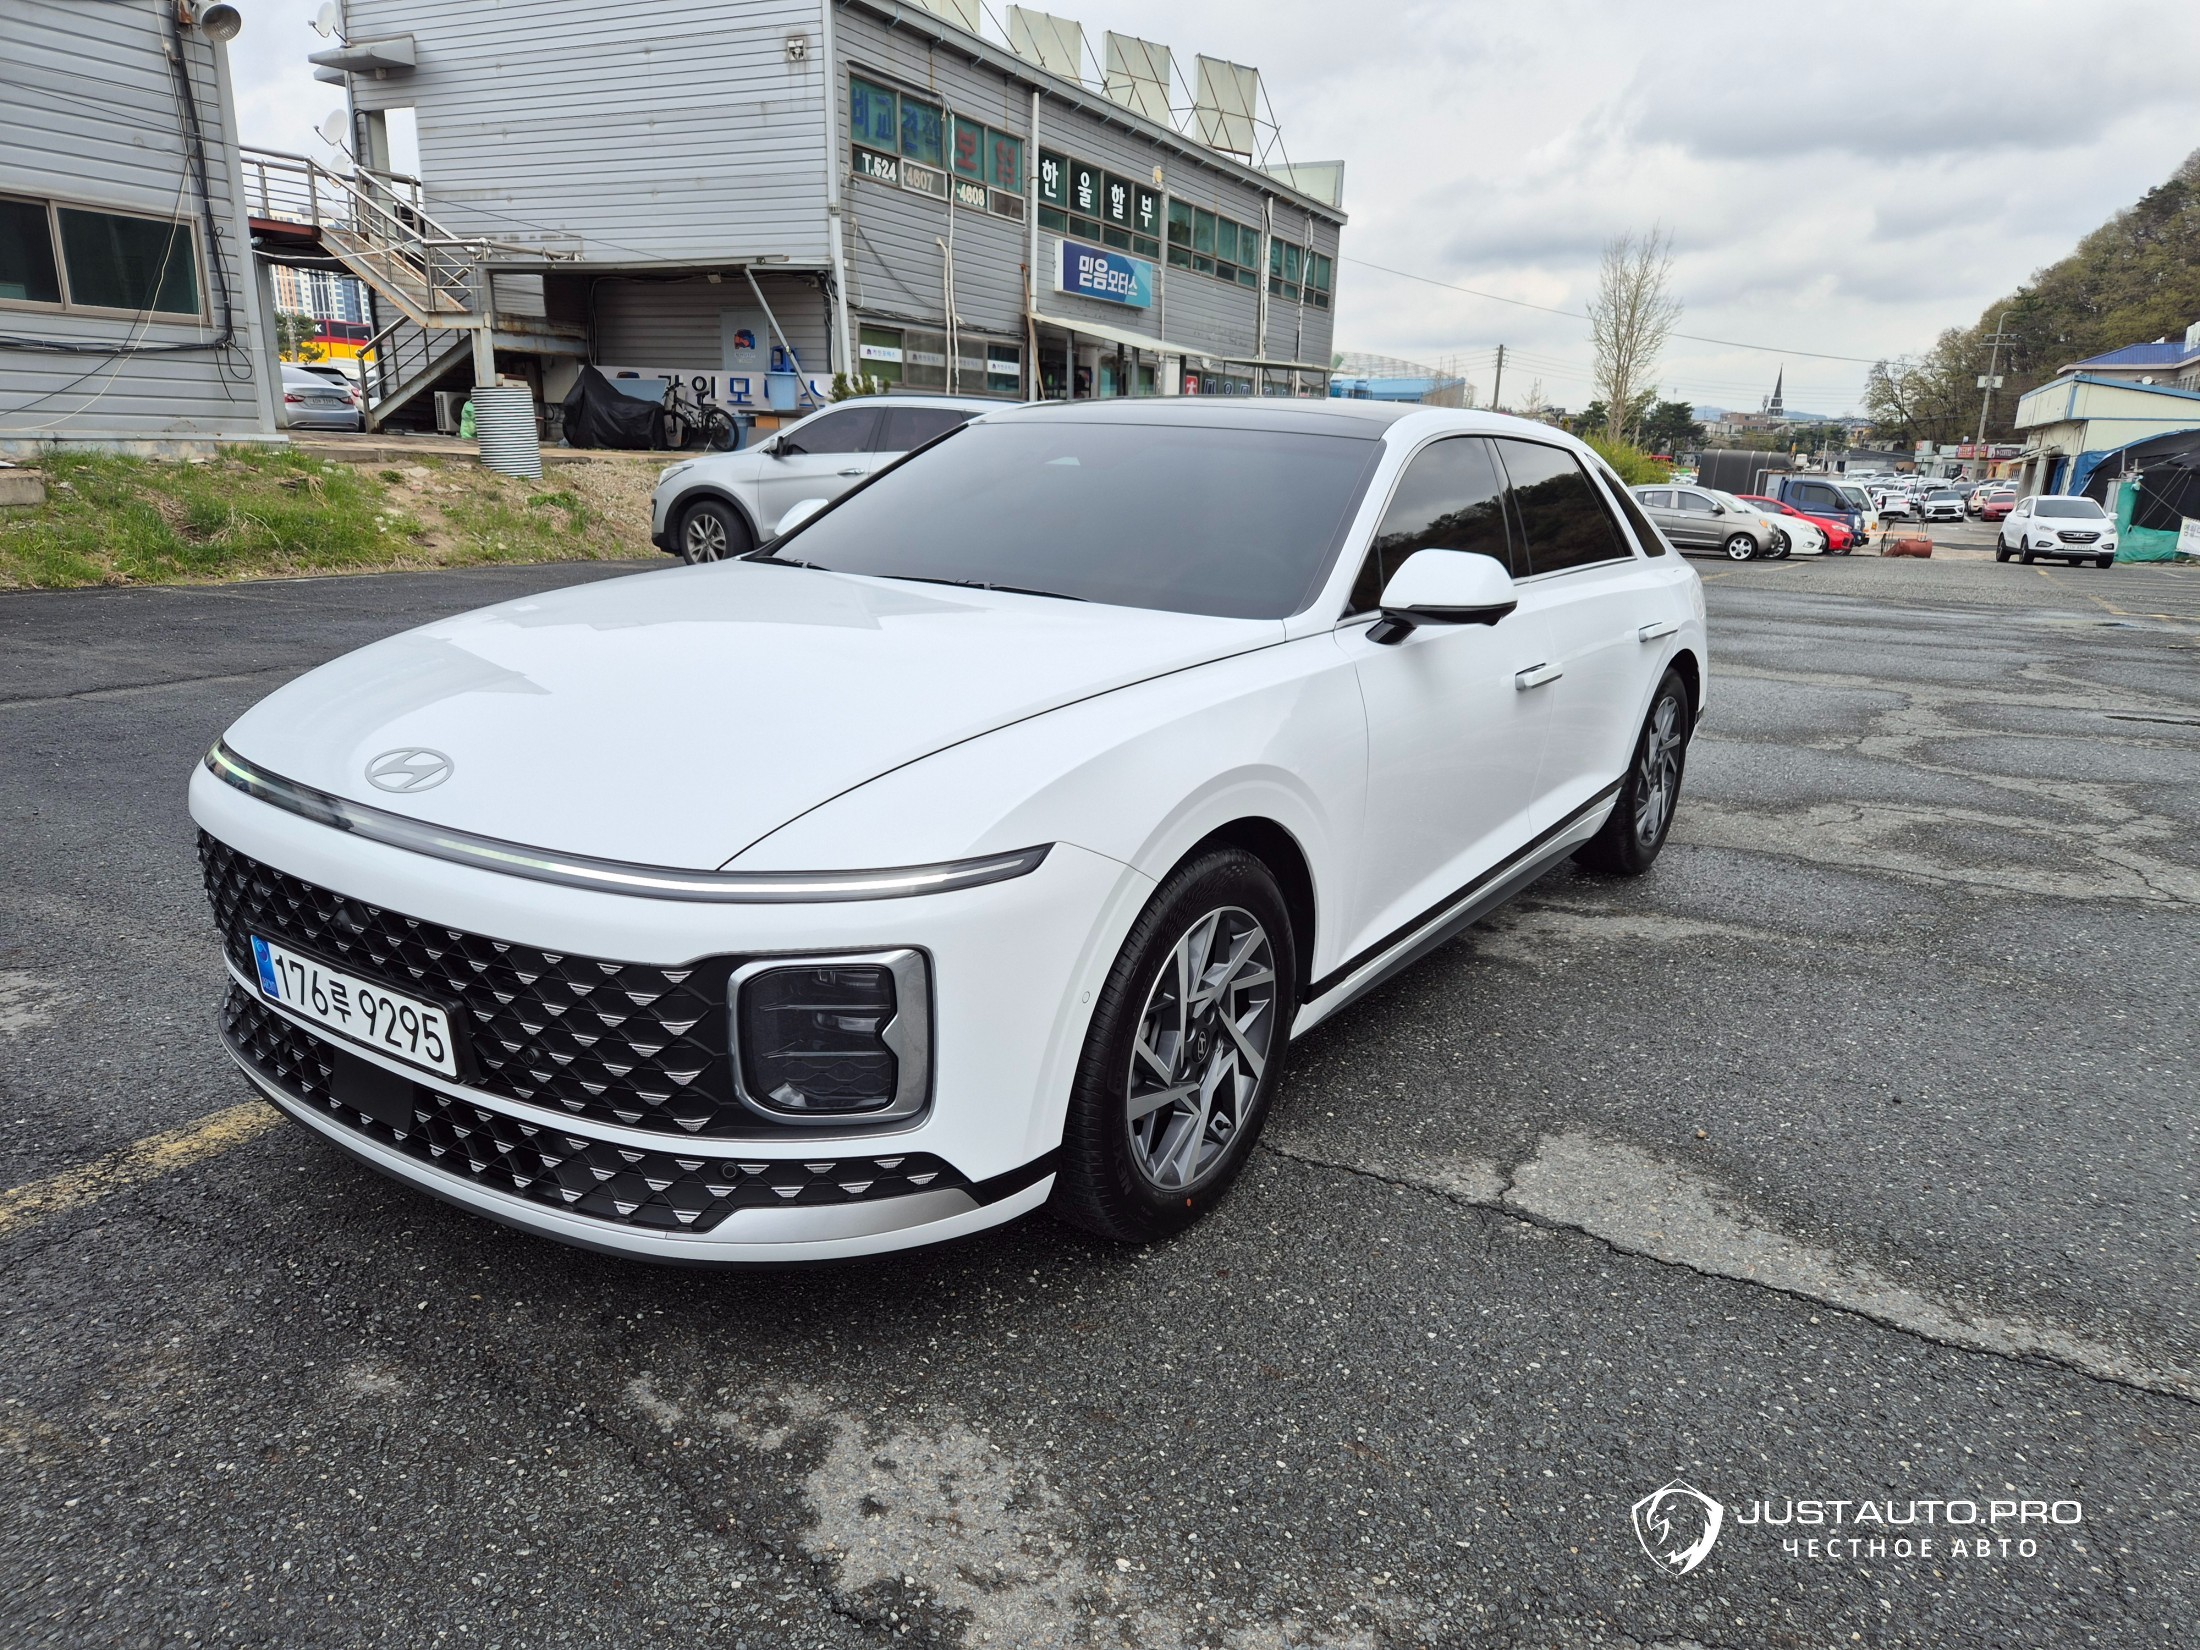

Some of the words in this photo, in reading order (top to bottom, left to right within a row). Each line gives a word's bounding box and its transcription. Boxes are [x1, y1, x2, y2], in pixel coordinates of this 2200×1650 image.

[862, 152, 897, 182] T.524
[1078, 255, 1138, 296] 믿음모터스
[275, 954, 352, 1024] 176루
[358, 989, 445, 1063] 9295
